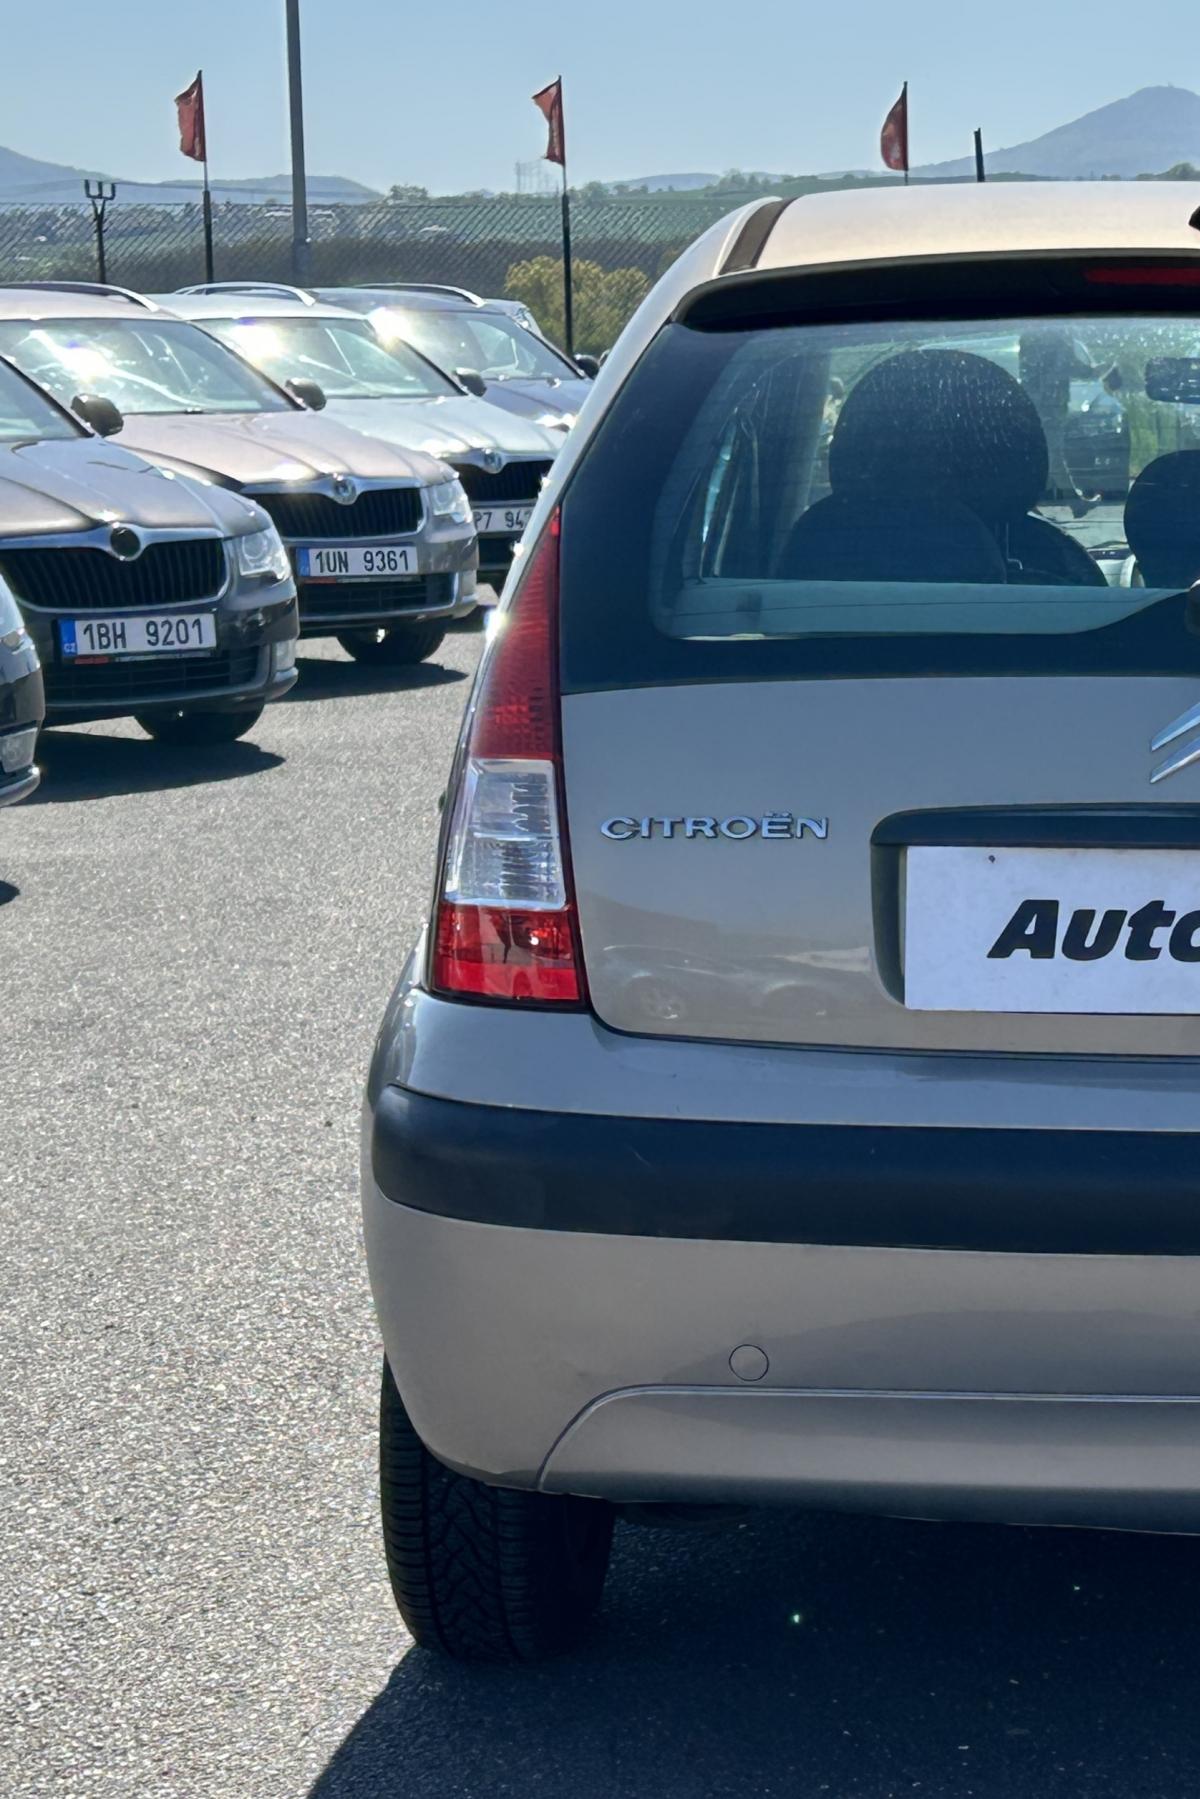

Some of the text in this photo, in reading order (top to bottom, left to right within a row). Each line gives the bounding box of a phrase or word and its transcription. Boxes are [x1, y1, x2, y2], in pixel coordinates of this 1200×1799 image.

[315, 550, 409, 574] 1UN 9361
[83, 618, 204, 650] 1BH 9201
[600, 811, 829, 840] CITROËN
